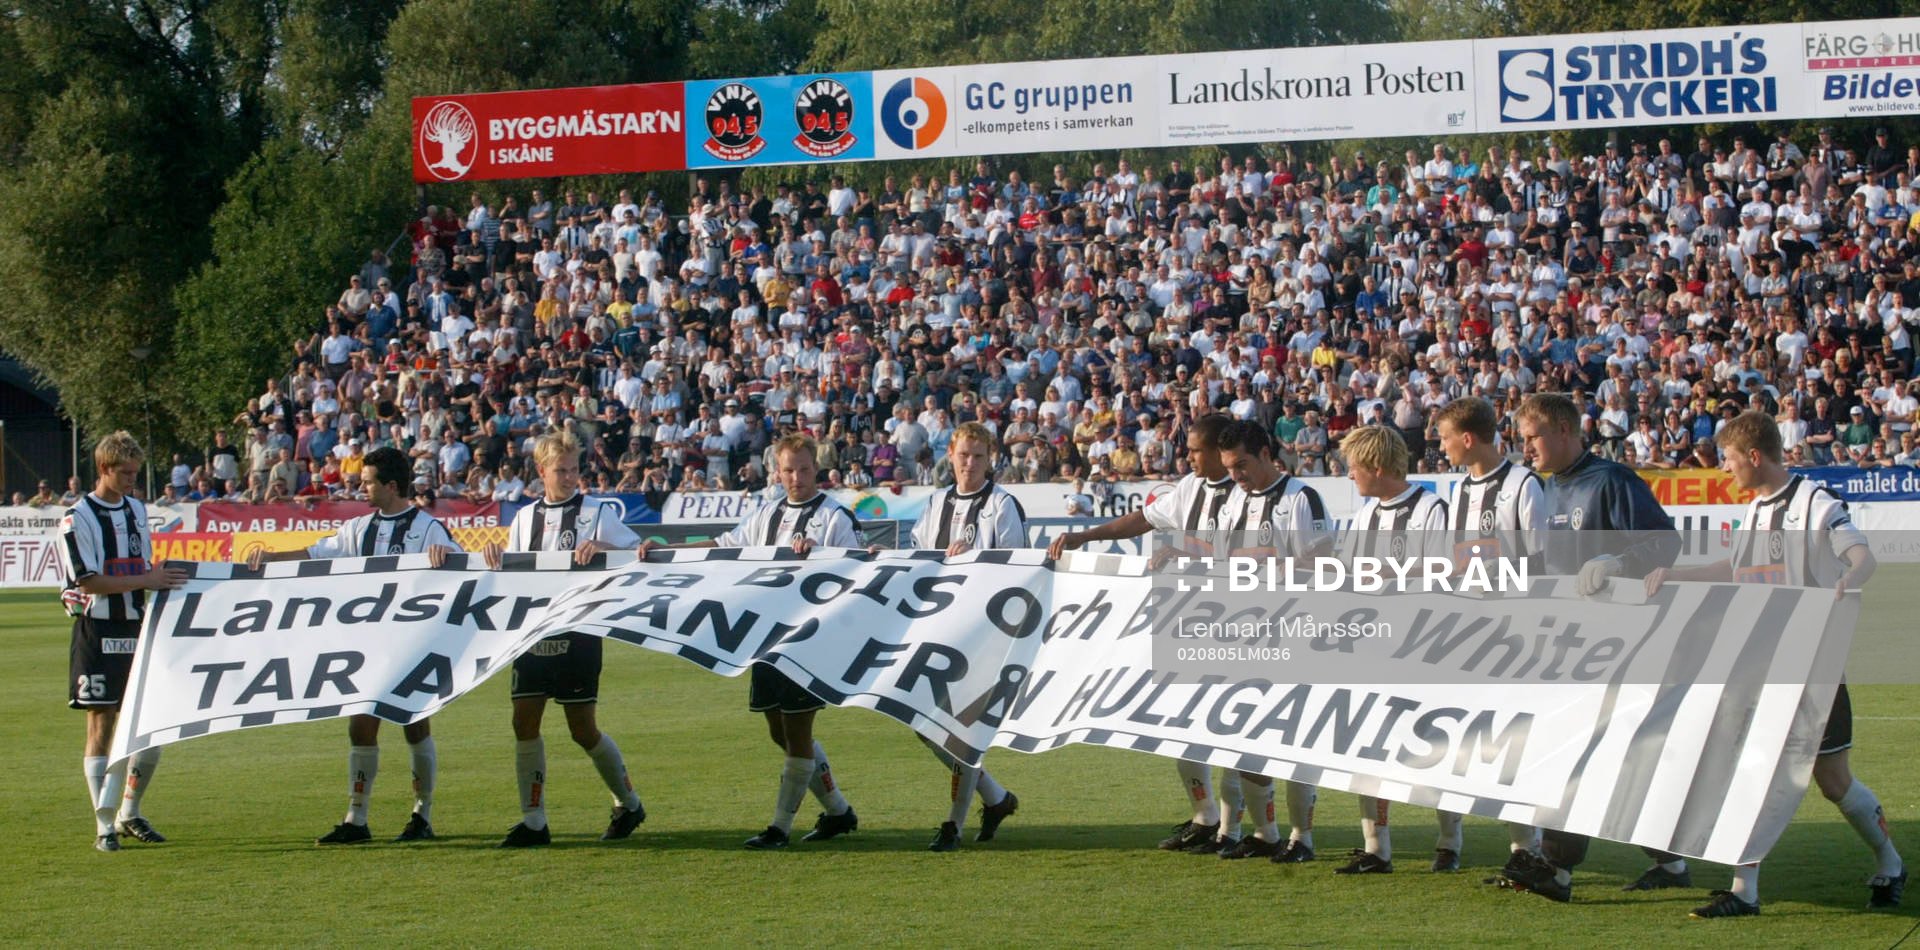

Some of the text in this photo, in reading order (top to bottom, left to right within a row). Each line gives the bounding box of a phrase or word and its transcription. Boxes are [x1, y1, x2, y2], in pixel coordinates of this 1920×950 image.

[1566, 32, 1767, 82] STRIDH'S
[1805, 33, 1868, 57] FÄRG
[797, 81, 850, 108] VINYL
[1168, 60, 1464, 106] Landskrona Posten
[708, 85, 759, 112] VINYL
[965, 81, 1133, 114] GC gruppen
[1559, 76, 1777, 121] TRYCKERI
[489, 108, 681, 141] BYGGMÄSTAR'N
[712, 115, 758, 139] 94,5
[802, 111, 848, 136] 94,5
[963, 115, 1133, 135] -elkompetens i samverkan
[489, 143, 554, 164] I SKÅNE
[1847, 471, 1897, 494] målet
[679, 495, 763, 519] PERF
[249, 517, 276, 532] AB
[283, 516, 348, 533] JANSS
[733, 565, 968, 620] BoIS
[986, 586, 1113, 645] Och
[1116, 586, 1308, 651] Black
[1309, 607, 1379, 655] &
[1390, 607, 1626, 681] White
[77, 674, 106, 699] 25
[190, 650, 366, 711] TAR
[1050, 665, 1536, 786] HULIGANISM
